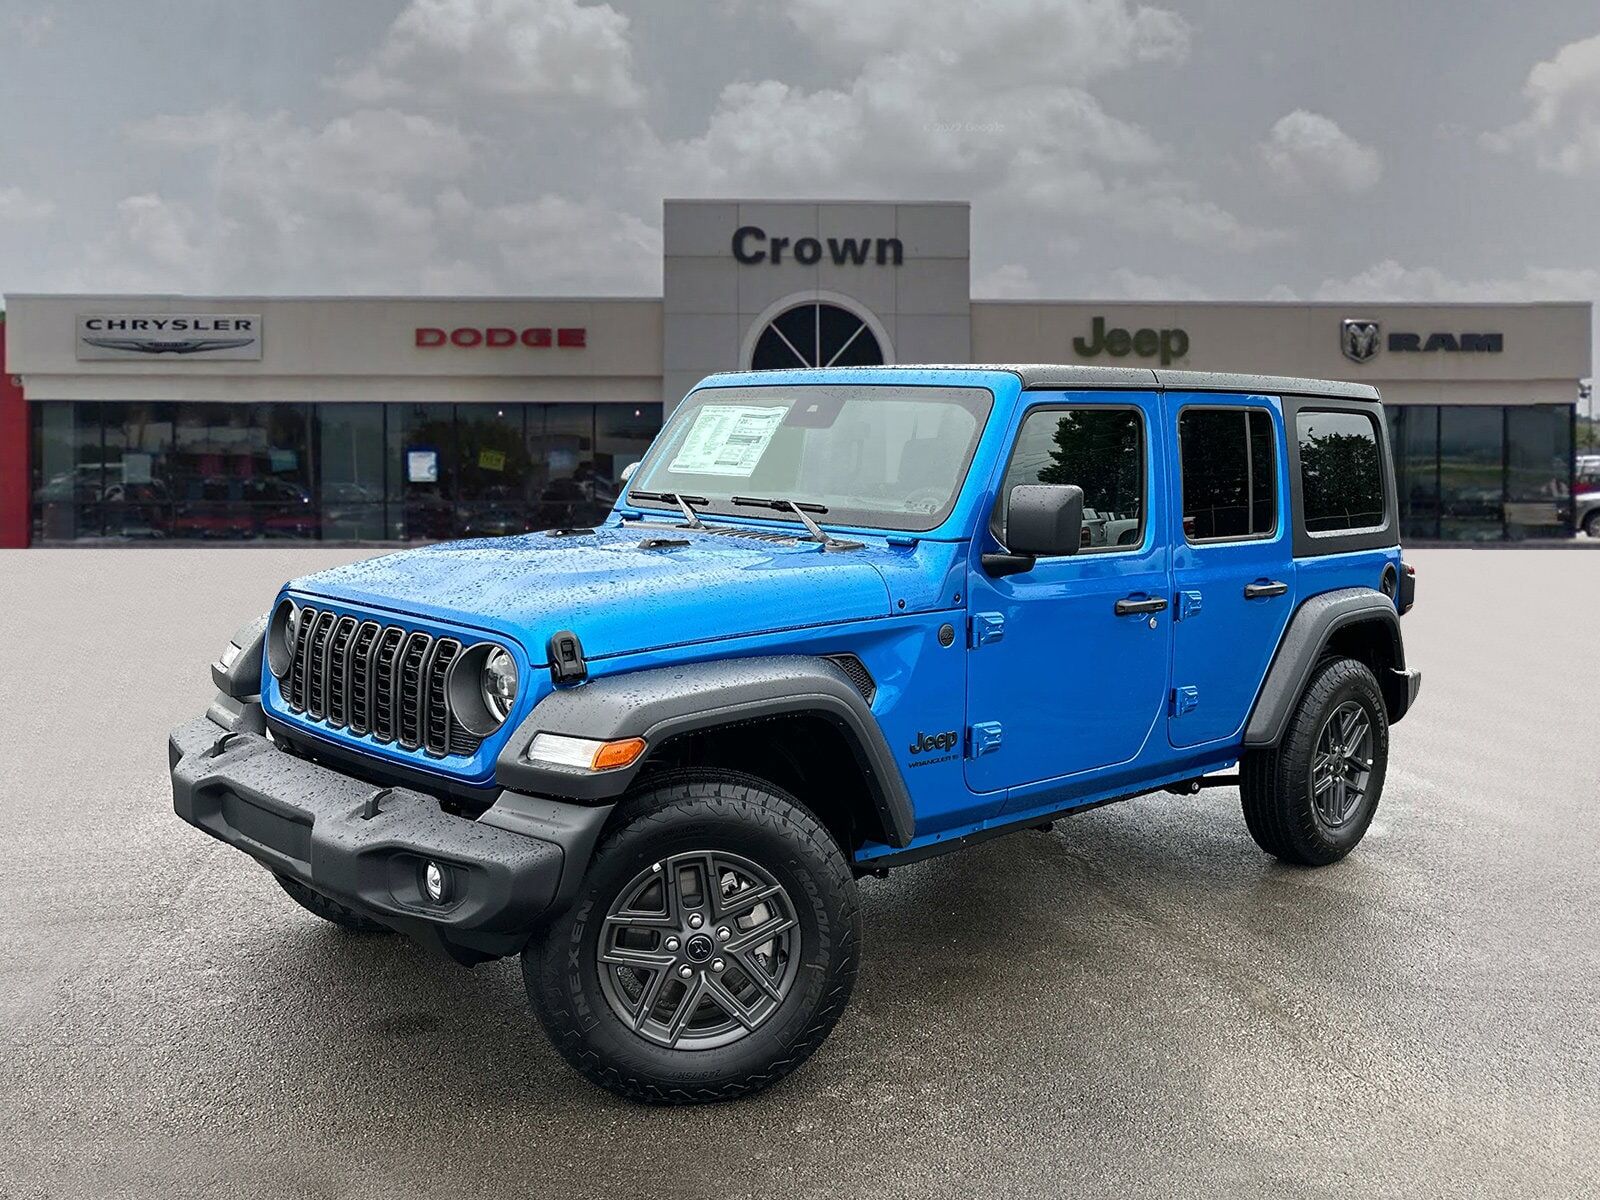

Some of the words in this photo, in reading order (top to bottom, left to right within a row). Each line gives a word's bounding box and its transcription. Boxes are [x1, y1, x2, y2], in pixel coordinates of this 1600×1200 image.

[731, 226, 904, 265] Crown
[85, 319, 252, 331] CHRYSLER
[415, 328, 587, 348] DODGE
[1072, 316, 1189, 366] Jeep
[1388, 332, 1503, 353] RAM
[909, 730, 958, 754] Jeep
[908, 755, 952, 768] WRANGLER
[793, 868, 831, 967] ROADIAN
[567, 900, 594, 1017] NEXEN
